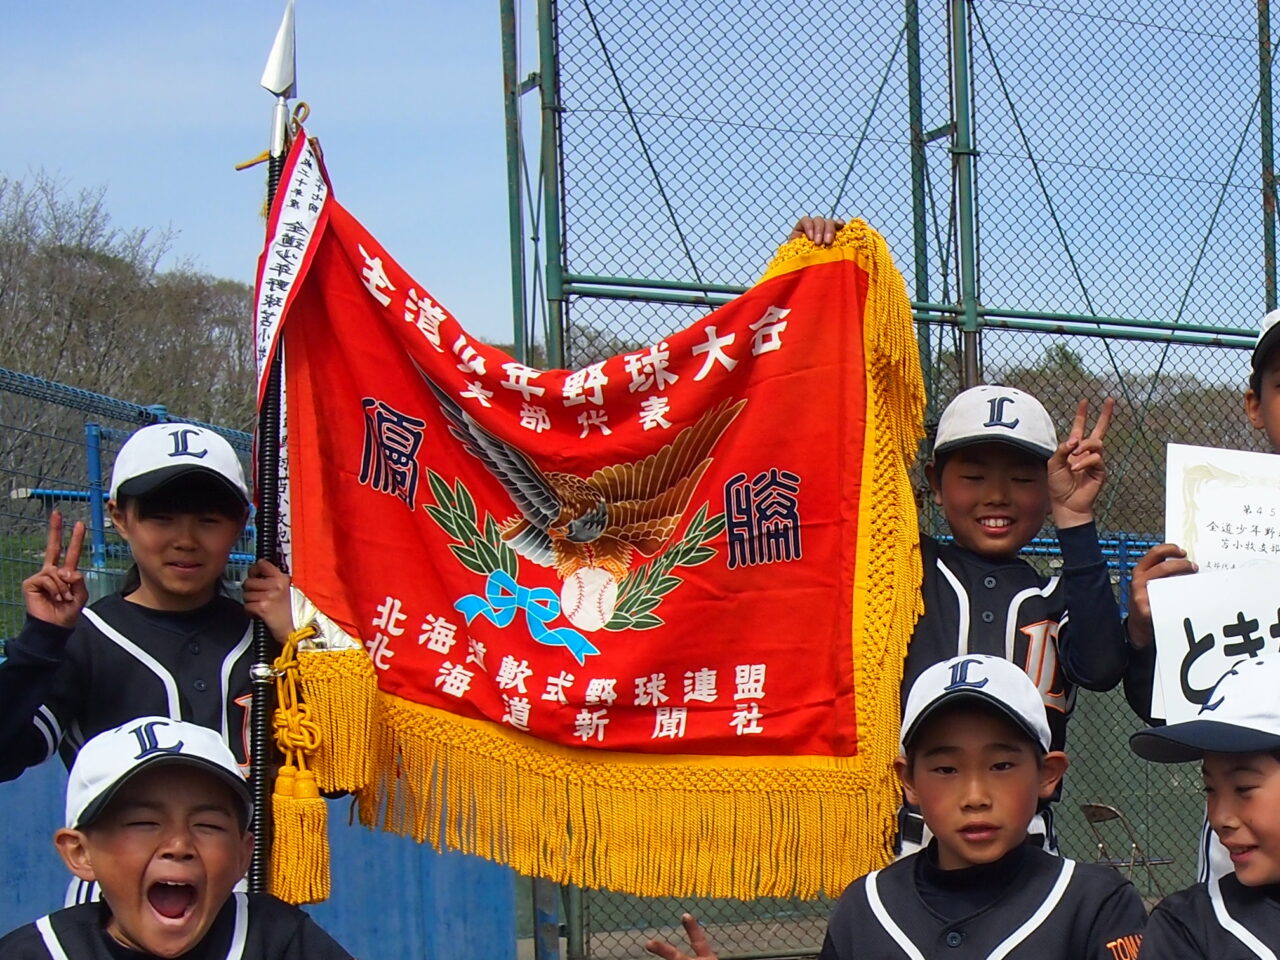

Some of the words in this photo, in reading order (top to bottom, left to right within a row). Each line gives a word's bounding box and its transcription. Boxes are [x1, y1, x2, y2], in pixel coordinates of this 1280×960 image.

[358, 243, 791, 407] 全道少年野球大会
[983, 397, 1019, 430] L
[168, 429, 207, 458] L
[372, 596, 766, 707] 北海道軟式野球連盟
[366, 632, 764, 742] 北海道新聞社
[944, 659, 988, 691] L
[128, 721, 183, 760] L
